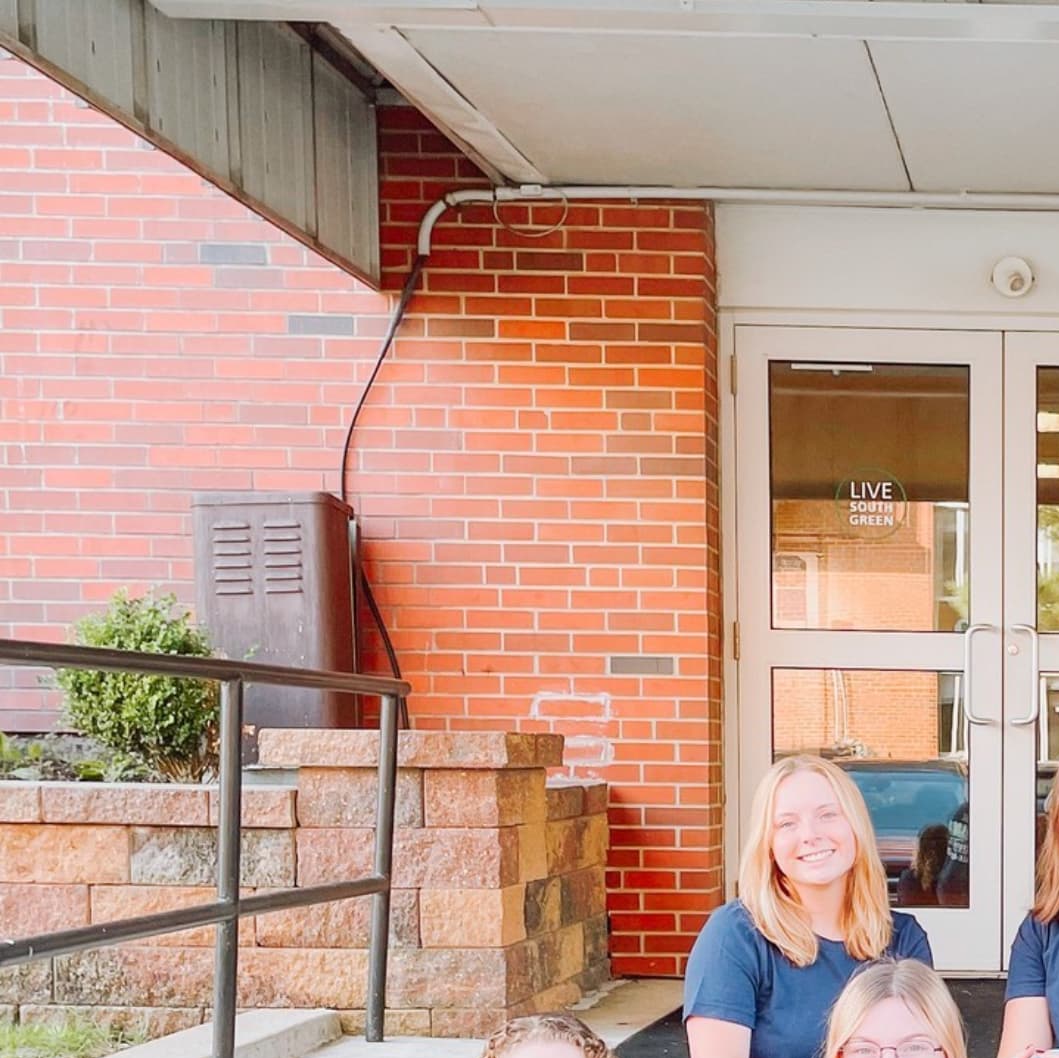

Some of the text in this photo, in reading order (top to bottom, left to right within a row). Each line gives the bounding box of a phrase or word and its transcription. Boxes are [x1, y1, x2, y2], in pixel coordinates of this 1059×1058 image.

[850, 481, 893, 500] LIVE
[849, 501, 894, 513] SOUTH
[849, 514, 894, 526] GREEN
